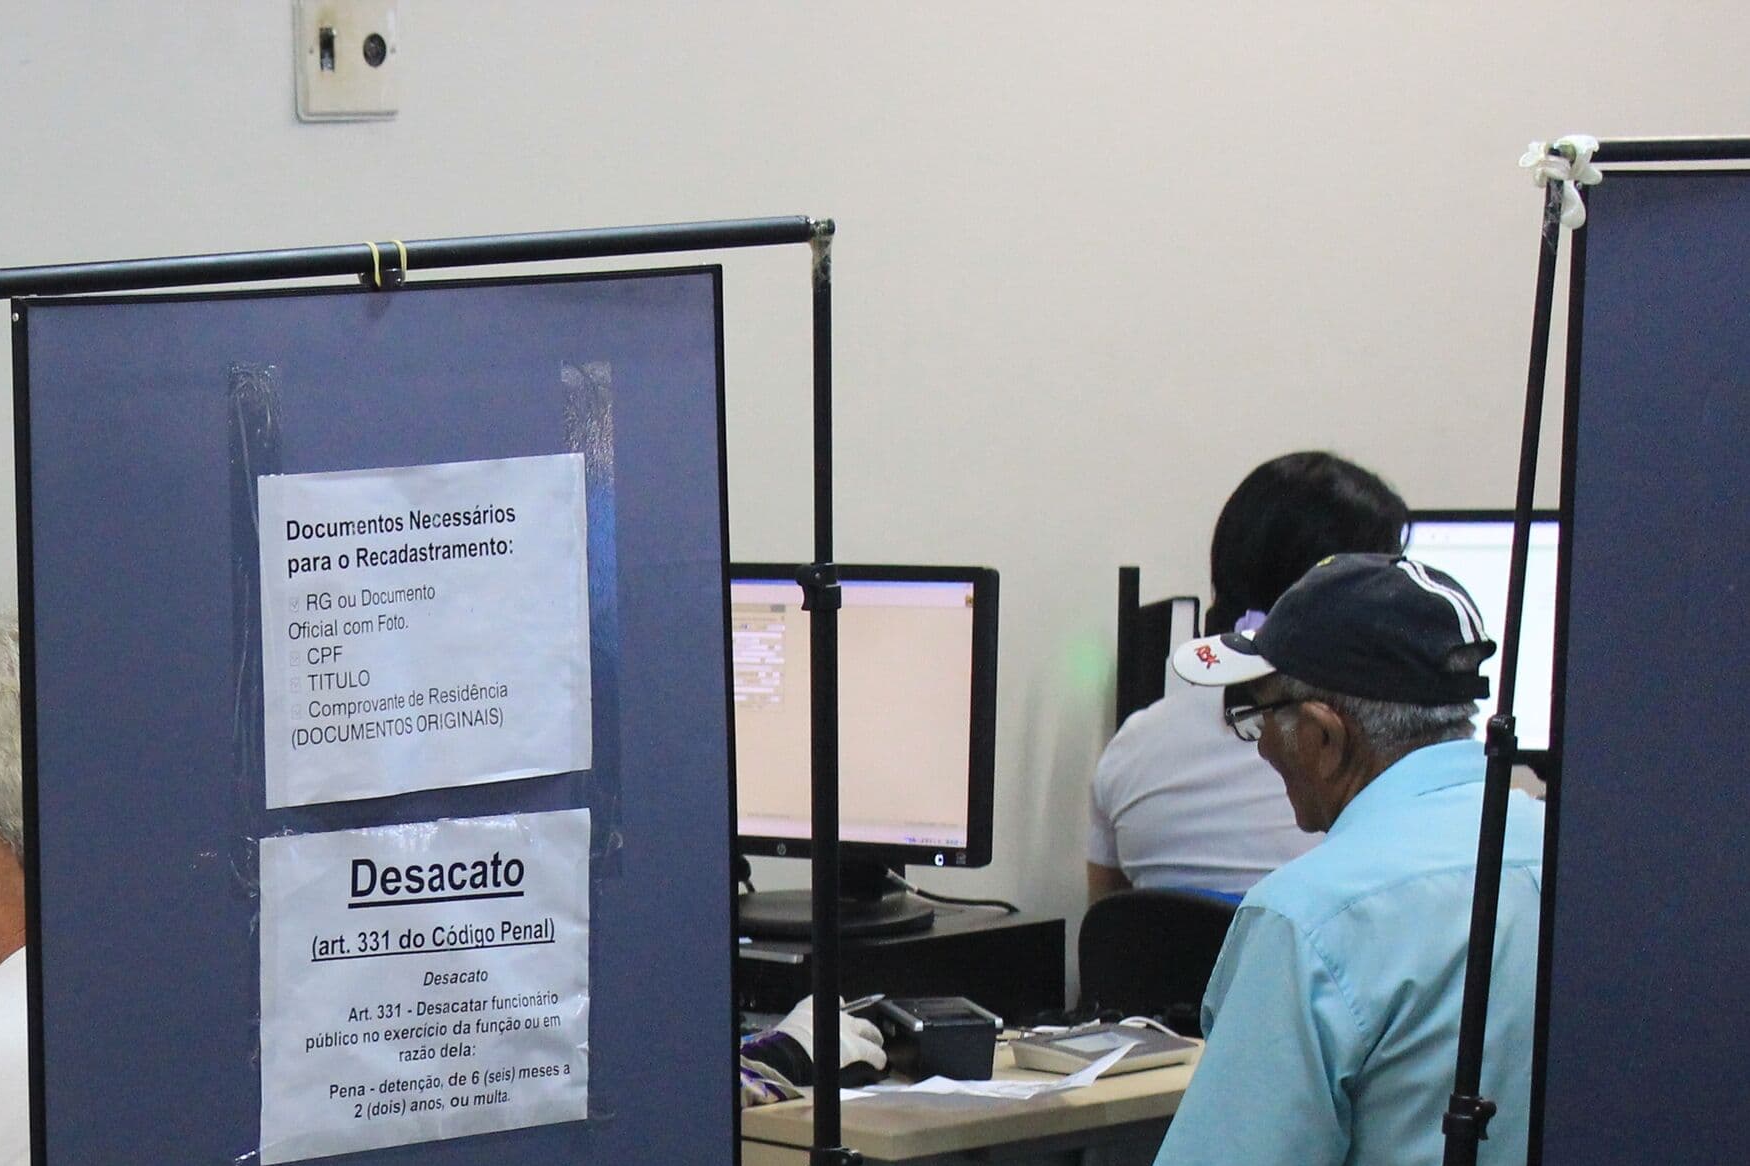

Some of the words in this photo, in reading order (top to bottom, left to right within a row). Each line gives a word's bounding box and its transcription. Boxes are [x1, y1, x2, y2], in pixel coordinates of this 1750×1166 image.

[286, 512, 404, 541] Documentos
[409, 505, 516, 530] Necessários
[287, 554, 331, 578] para
[338, 554, 349, 569] o
[356, 538, 514, 568] Recadastramento:
[306, 592, 332, 610] RG
[337, 595, 357, 608] ou
[362, 584, 436, 606] Documento
[288, 620, 338, 640] Oficial
[343, 619, 374, 634] com
[378, 615, 409, 632] Foto.
[307, 646, 343, 665] CPF
[308, 670, 371, 691] TITULO
[308, 693, 405, 721] Comprovante
[408, 690, 424, 706] de
[429, 682, 508, 704] Residência
[291, 718, 413, 749] (DOCUMENTOS
[417, 708, 504, 732] ORIGINAIS)
[351, 851, 525, 898] Desacato
[311, 935, 351, 960] (art.
[357, 929, 391, 953] 331
[399, 928, 425, 950] do
[432, 924, 495, 949] Código
[501, 917, 555, 944] Penal)
[423, 969, 489, 986] Desacato
[348, 1005, 373, 1023] Art.
[377, 1003, 401, 1019] 331
[417, 998, 488, 1017] Desacatar
[491, 992, 559, 1011] funcionário
[306, 1032, 359, 1053] público
[363, 1030, 380, 1043] no
[383, 1022, 447, 1042] exercício
[452, 1020, 471, 1036] da
[476, 1016, 521, 1036] função
[524, 1016, 540, 1030] ou
[543, 1014, 561, 1028] em
[399, 1045, 436, 1062] razão
[439, 1043, 476, 1058] dela:
[329, 1084, 365, 1099] Pena
[378, 1075, 444, 1095] detenção,
[448, 1071, 468, 1087] de
[471, 1070, 480, 1085] 6
[483, 1066, 515, 1087] (seis)
[518, 1064, 559, 1080] meses
[562, 1063, 570, 1075] a
[354, 1104, 363, 1118] 2
[367, 1099, 406, 1121] (dois)
[410, 1097, 445, 1113] anos,
[450, 1095, 469, 1108] ou
[473, 1091, 511, 1106] multa.
